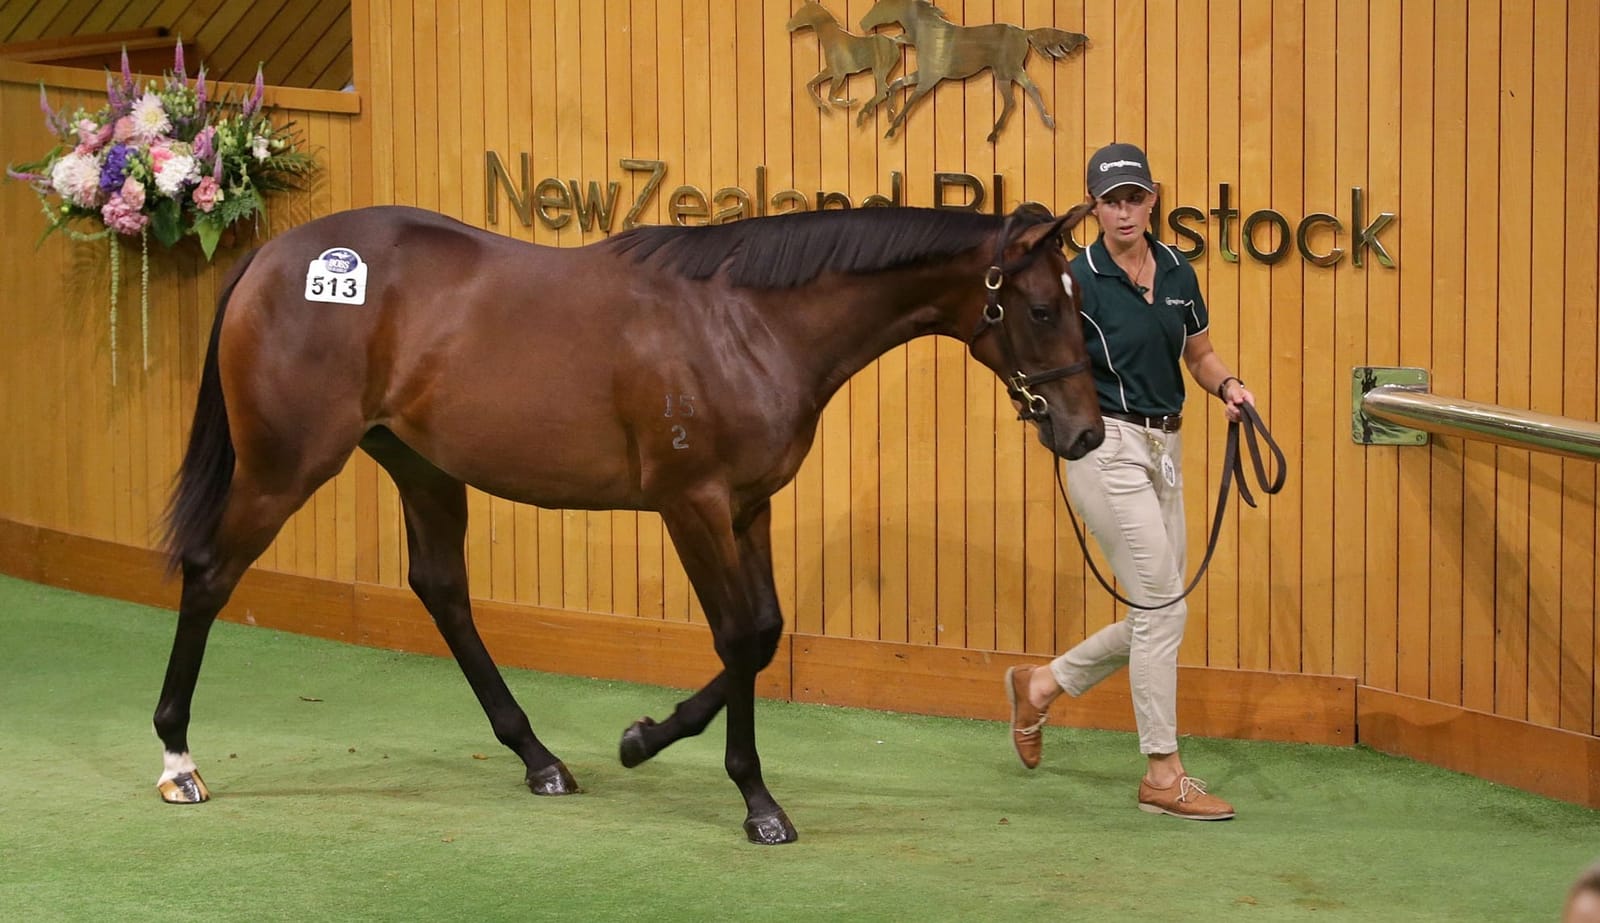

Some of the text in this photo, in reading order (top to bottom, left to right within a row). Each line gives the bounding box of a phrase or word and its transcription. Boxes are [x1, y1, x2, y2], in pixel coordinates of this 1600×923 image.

[933, 171, 1396, 268] Blostock
[311, 276, 357, 298] 513
[671, 424, 689, 450] 2
